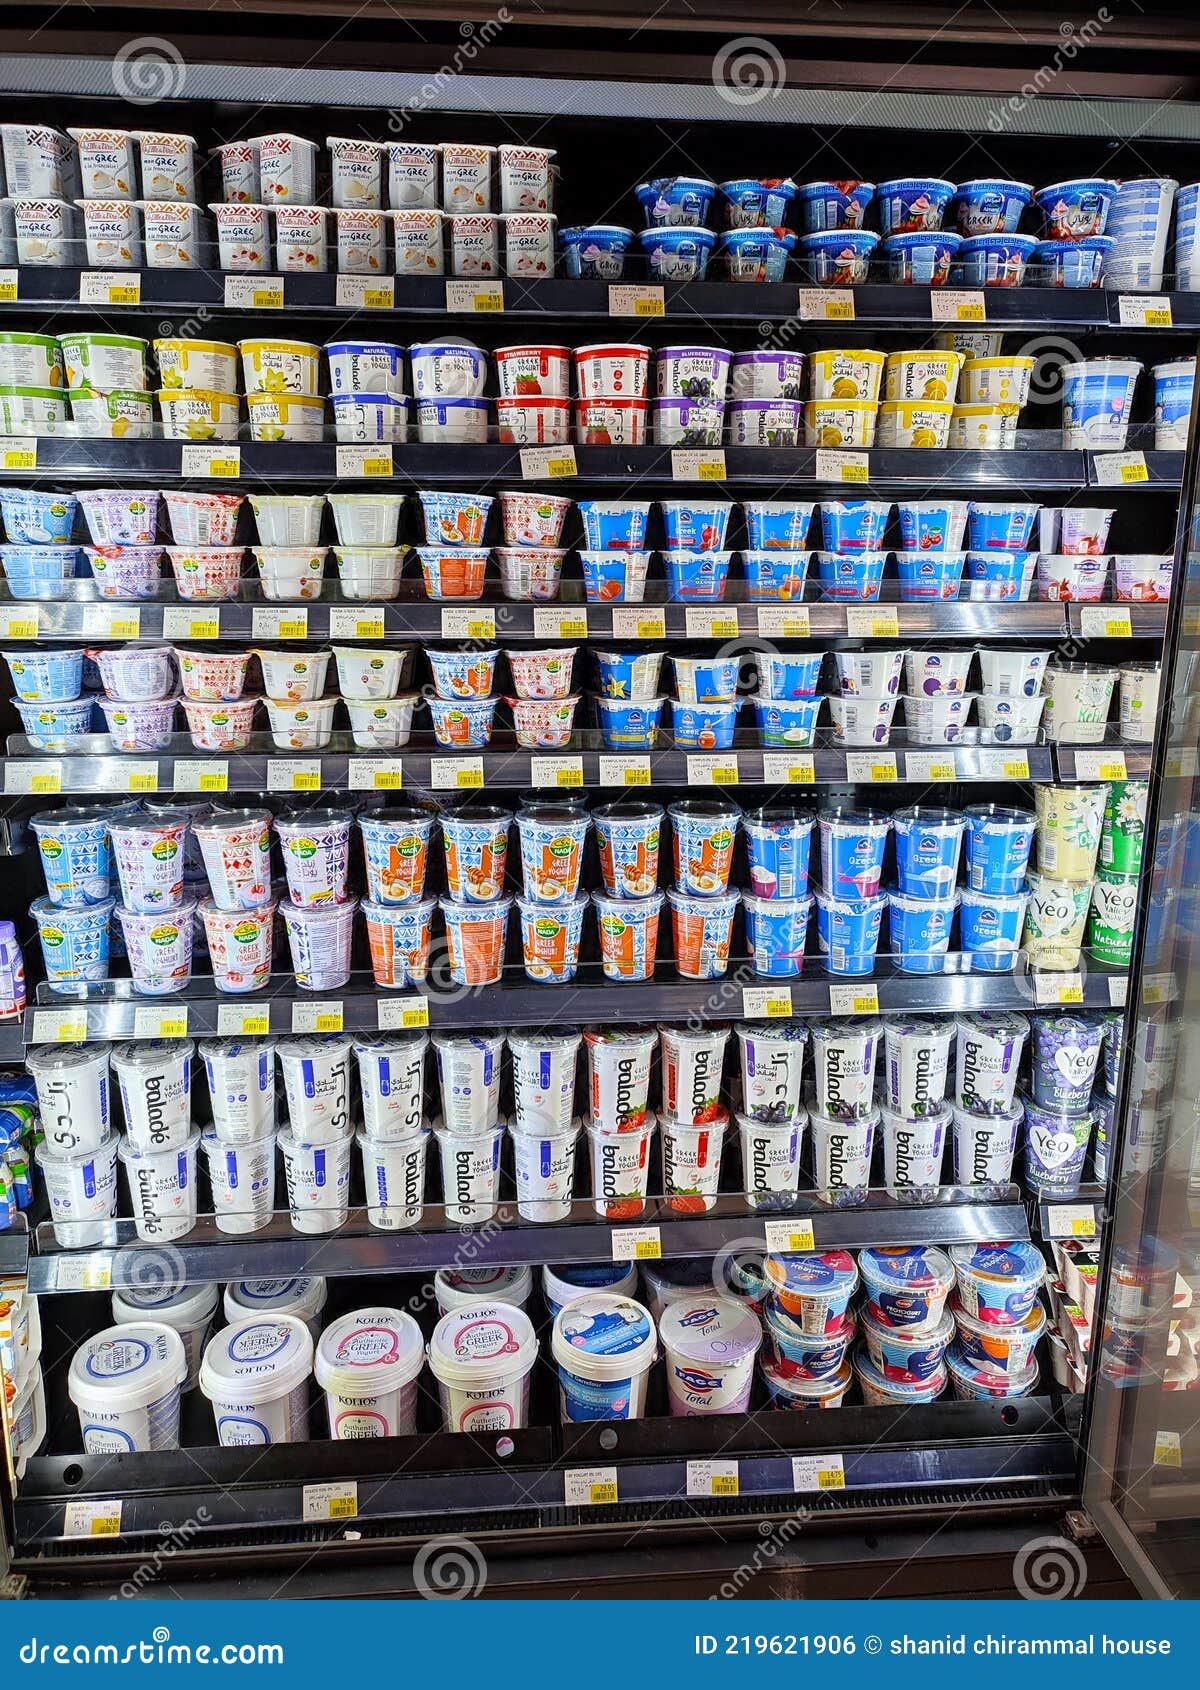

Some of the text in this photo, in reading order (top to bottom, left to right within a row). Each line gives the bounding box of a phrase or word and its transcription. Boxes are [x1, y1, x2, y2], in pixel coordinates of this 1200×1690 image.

[95, 154, 118, 163] GREC
[155, 158, 178, 167] GREC
[351, 164, 372, 174] GREC
[407, 168, 428, 177] GREC
[458, 168, 479, 177] GREC
[522, 172, 542, 181] GREC
[29, 223, 51, 232] GREC
[100, 223, 122, 232] GREC
[158, 225, 181, 233] GREC
[232, 227, 255, 236] GREC
[290, 229, 311, 238] GREC
[351, 232, 371, 241] GREC
[408, 232, 429, 242] GREC
[463, 237, 484, 246] GREC
[519, 237, 540, 246] GREC
[504, 350, 541, 358] STRAWBERRY
[351, 355, 360, 391] baladé
[432, 357, 441, 392] baladé
[634, 359, 642, 396] baladé
[672, 359, 681, 396] baladé
[501, 360, 510, 398] baladé
[906, 363, 915, 399] baladé
[758, 411, 767, 444] baladé
[676, 528, 696, 536] Greek
[44, 848, 60, 857] NADA
[156, 851, 174, 859] NADA
[849, 856, 876, 865] Greco
[913, 855, 942, 864] Greek
[155, 863, 176, 871] GREEK
[152, 871, 178, 881] YOGHURT
[1100, 888, 1134, 908] Yeo
[1035, 897, 1068, 918] Yeo
[605, 926, 620, 934] NADA
[921, 930, 946, 938] Greek
[973, 925, 1002, 936] Greek
[44, 936, 61, 945] NADA
[155, 936, 174, 944] NADA
[238, 934, 257, 942] NADA
[536, 939, 555, 947] GREEK
[1094, 933, 1132, 946] Natural
[155, 948, 175, 956] GREEK
[239, 945, 259, 953] GREEK
[534, 947, 557, 955] YOGHURT
[152, 955, 178, 964] YOGHURT
[235, 953, 261, 963] YOGHURT
[1064, 1052, 1095, 1067] Yeo
[164, 1080, 183, 1091] GREEK
[164, 1086, 184, 1098] YOGURT
[1053, 1087, 1090, 1099] Blueberry
[145, 1076, 170, 1144] baladé
[1035, 1130, 1069, 1153] Yeo
[473, 1158, 491, 1166] GREEK
[619, 1161, 639, 1169] YOGURT
[1029, 1165, 1070, 1182] Blueberry
[155, 1176, 177, 1185] GREEK
[406, 1149, 420, 1218] baladé
[456, 1151, 476, 1215] baladé
[155, 1182, 178, 1191] YOGURT
[286, 1154, 300, 1222] baladé
[138, 1168, 163, 1234] baladé
[459, 1309, 497, 1320] KOLIOS
[681, 1309, 719, 1326] FAGE
[355, 1316, 394, 1325] KOLIOS
[696, 1322, 722, 1336] Total
[239, 1338, 278, 1350] GREEK
[466, 1334, 503, 1345] GREEK
[156, 1335, 168, 1360] KOLIOS
[350, 1342, 388, 1351] GREEK
[711, 1340, 742, 1352] 0%
[234, 1363, 277, 1375] KOLIOS
[677, 1371, 719, 1386] FAGE
[466, 1388, 505, 1399] KOLIOS
[684, 1390, 712, 1405] Total
[338, 1395, 377, 1406] KOLIOS
[471, 1415, 505, 1424] Authentic
[470, 1422, 505, 1432] GREEK
[343, 1430, 378, 1439] GREEK
[89, 1437, 121, 1448] Authentic
